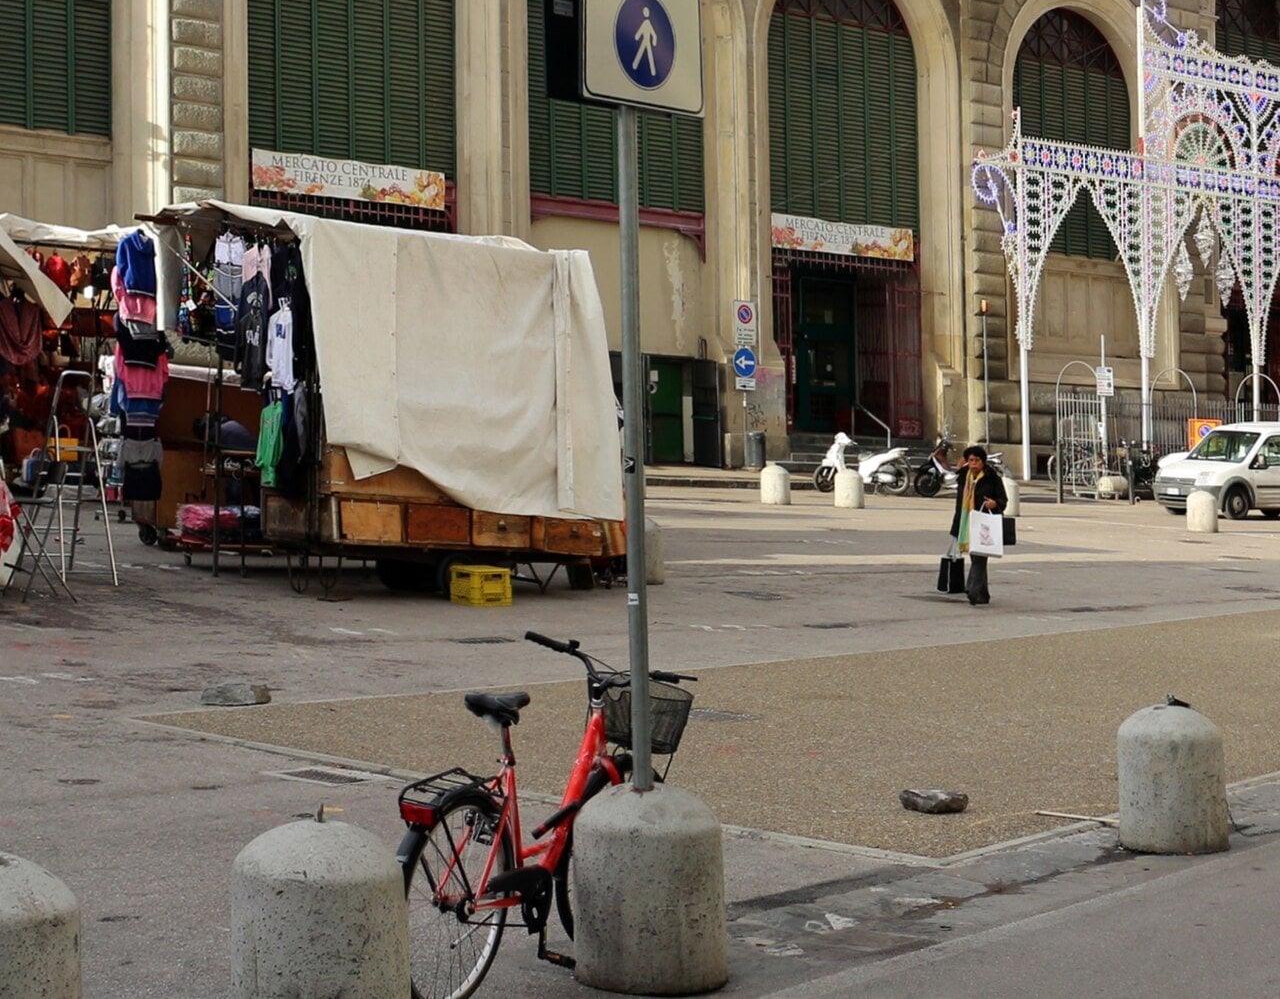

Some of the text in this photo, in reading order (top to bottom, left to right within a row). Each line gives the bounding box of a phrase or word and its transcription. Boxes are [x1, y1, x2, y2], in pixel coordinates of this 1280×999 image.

[272, 155, 408, 181] MERCATO CENTRALE
[293, 170, 371, 188] FIRENZE 1874
[785, 218, 885, 238] MERCATO CENTRALE
[801, 231, 839, 244] FIRENZE
